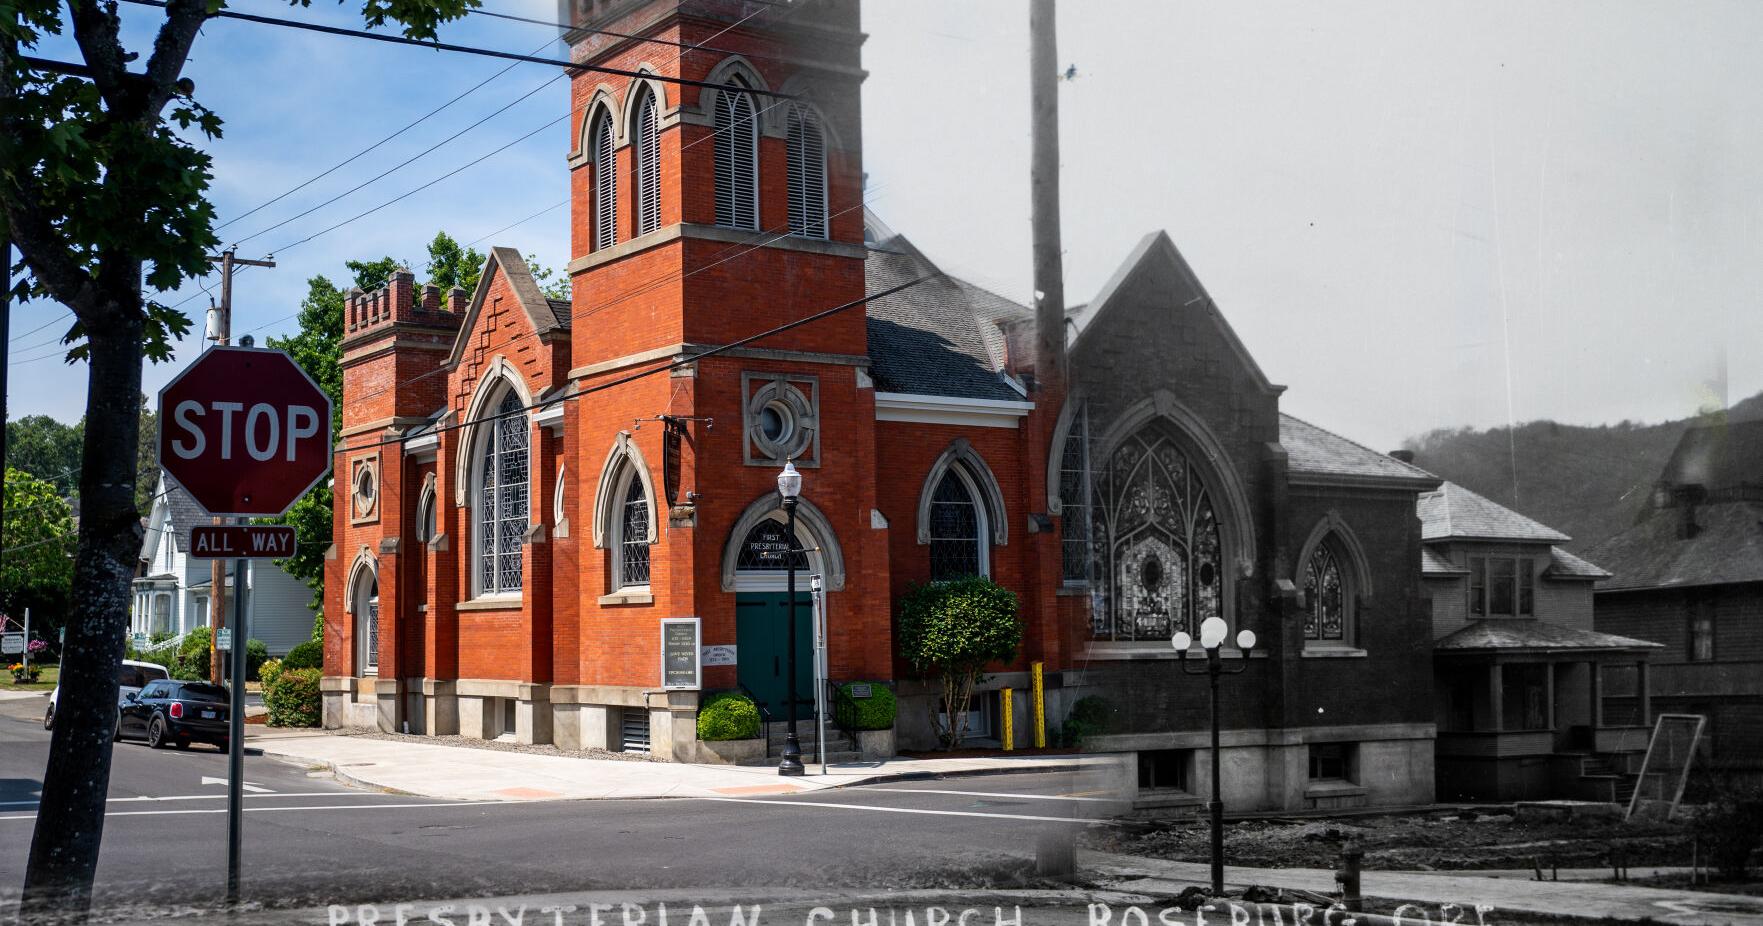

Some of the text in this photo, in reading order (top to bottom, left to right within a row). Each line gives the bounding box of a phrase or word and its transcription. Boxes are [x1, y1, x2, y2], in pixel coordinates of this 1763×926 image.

[171, 399, 320, 462] STOP
[196, 532, 290, 552] ALL WAY
